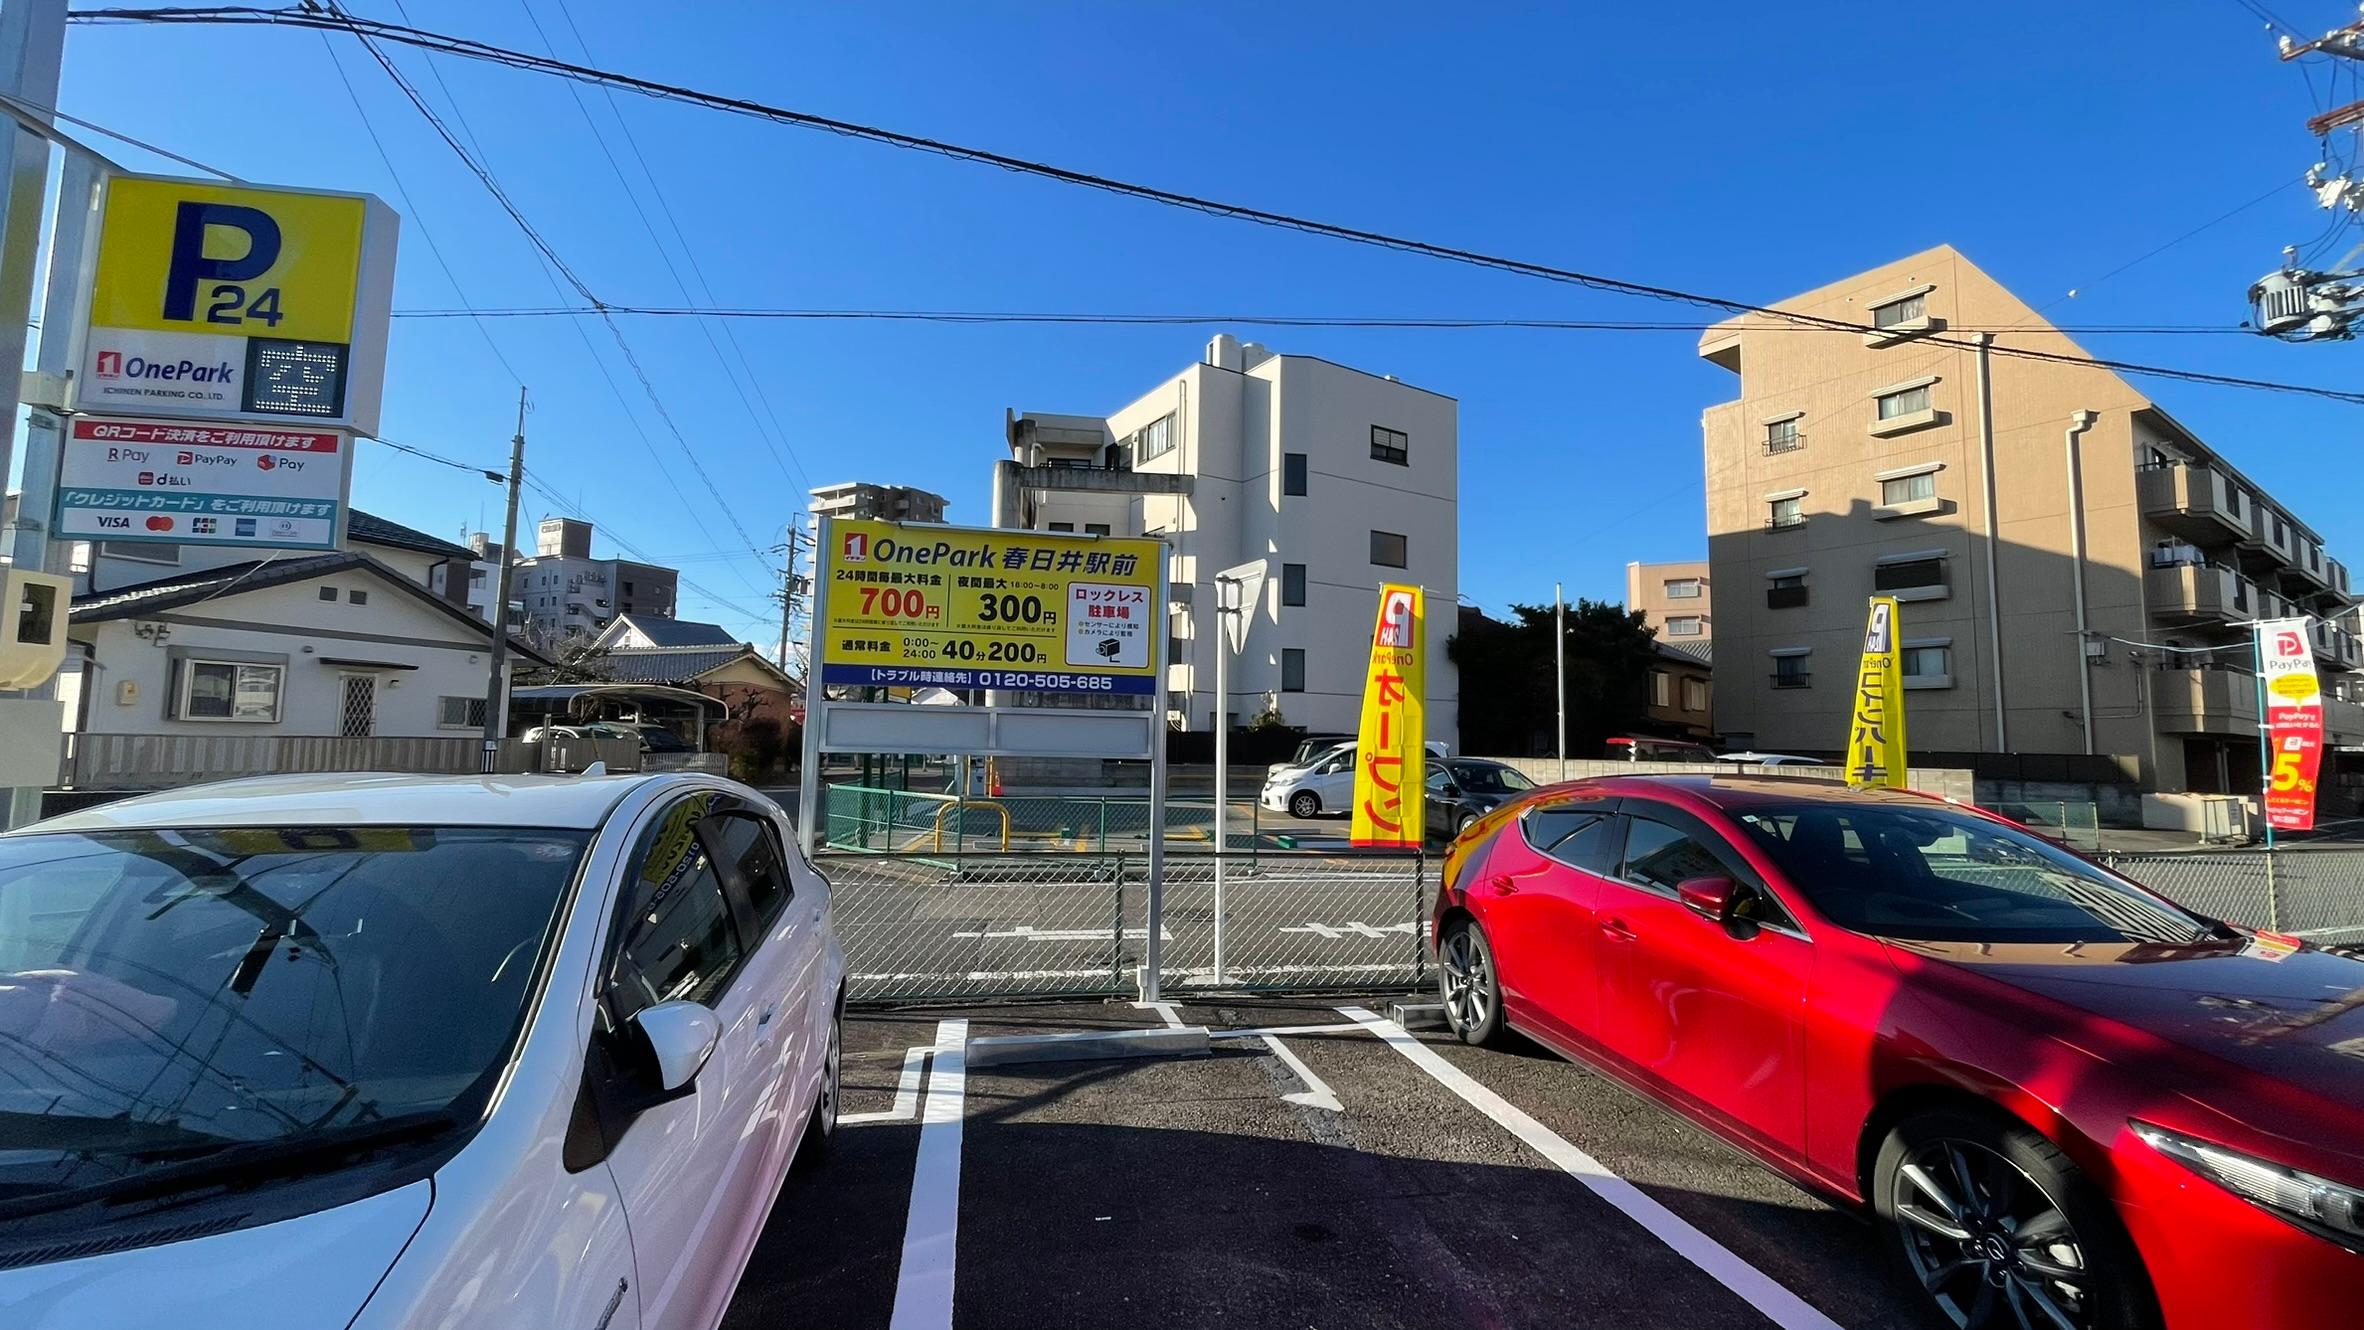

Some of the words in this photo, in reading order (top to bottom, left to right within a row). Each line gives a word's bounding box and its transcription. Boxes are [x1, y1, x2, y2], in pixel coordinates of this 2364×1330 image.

[163, 200, 282, 321] P
[206, 285, 283, 327] 24
[125, 357, 234, 384] OnePark
[255, 345, 337, 414] 空
[144, 389, 184, 399] PARKING
[93, 424, 316, 449] QRコード決済をご利用頂けます
[122, 448, 150, 463] Pay
[195, 453, 238, 468] PayPay
[279, 457, 305, 472] Pay
[97, 516, 130, 529] VISA
[873, 537, 997, 569] OnePark
[1002, 546, 1138, 576] 春日井駅前
[836, 569, 942, 586] 24時間毎最大料金
[957, 576, 1008, 589] 夜間最大
[860, 587, 940, 619] 700円
[1075, 588, 1144, 603] ロックレス
[978, 593, 1057, 625] 300円
[1088, 604, 1130, 619] 駐車場
[841, 639, 892, 653] 通常料金
[902, 649, 936, 660] 24:00
[979, 672, 1113, 690] 0120-505-685
